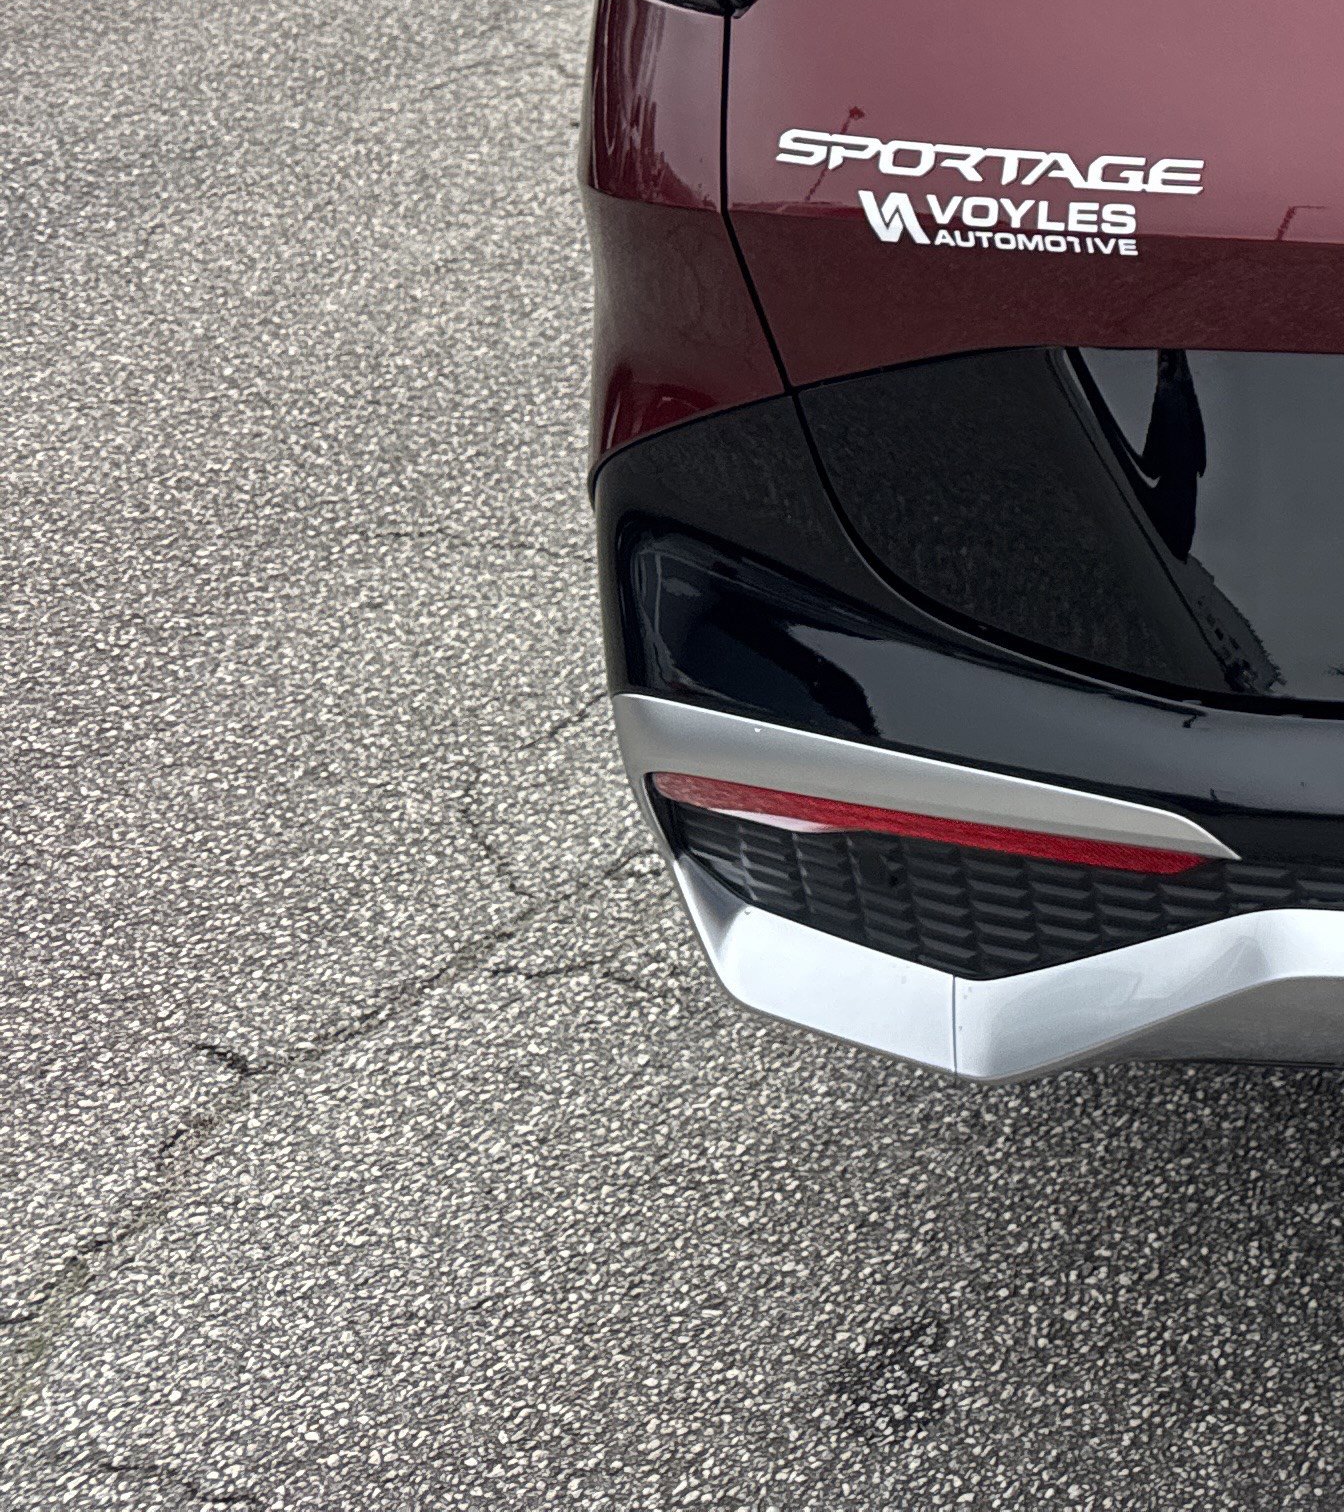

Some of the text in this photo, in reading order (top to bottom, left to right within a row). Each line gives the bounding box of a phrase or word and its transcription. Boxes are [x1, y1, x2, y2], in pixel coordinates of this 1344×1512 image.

[775, 128, 1204, 195] SPORTAGE
[927, 194, 1137, 235] VOYLES
[933, 231, 1139, 256] AUTOMOTIVE
